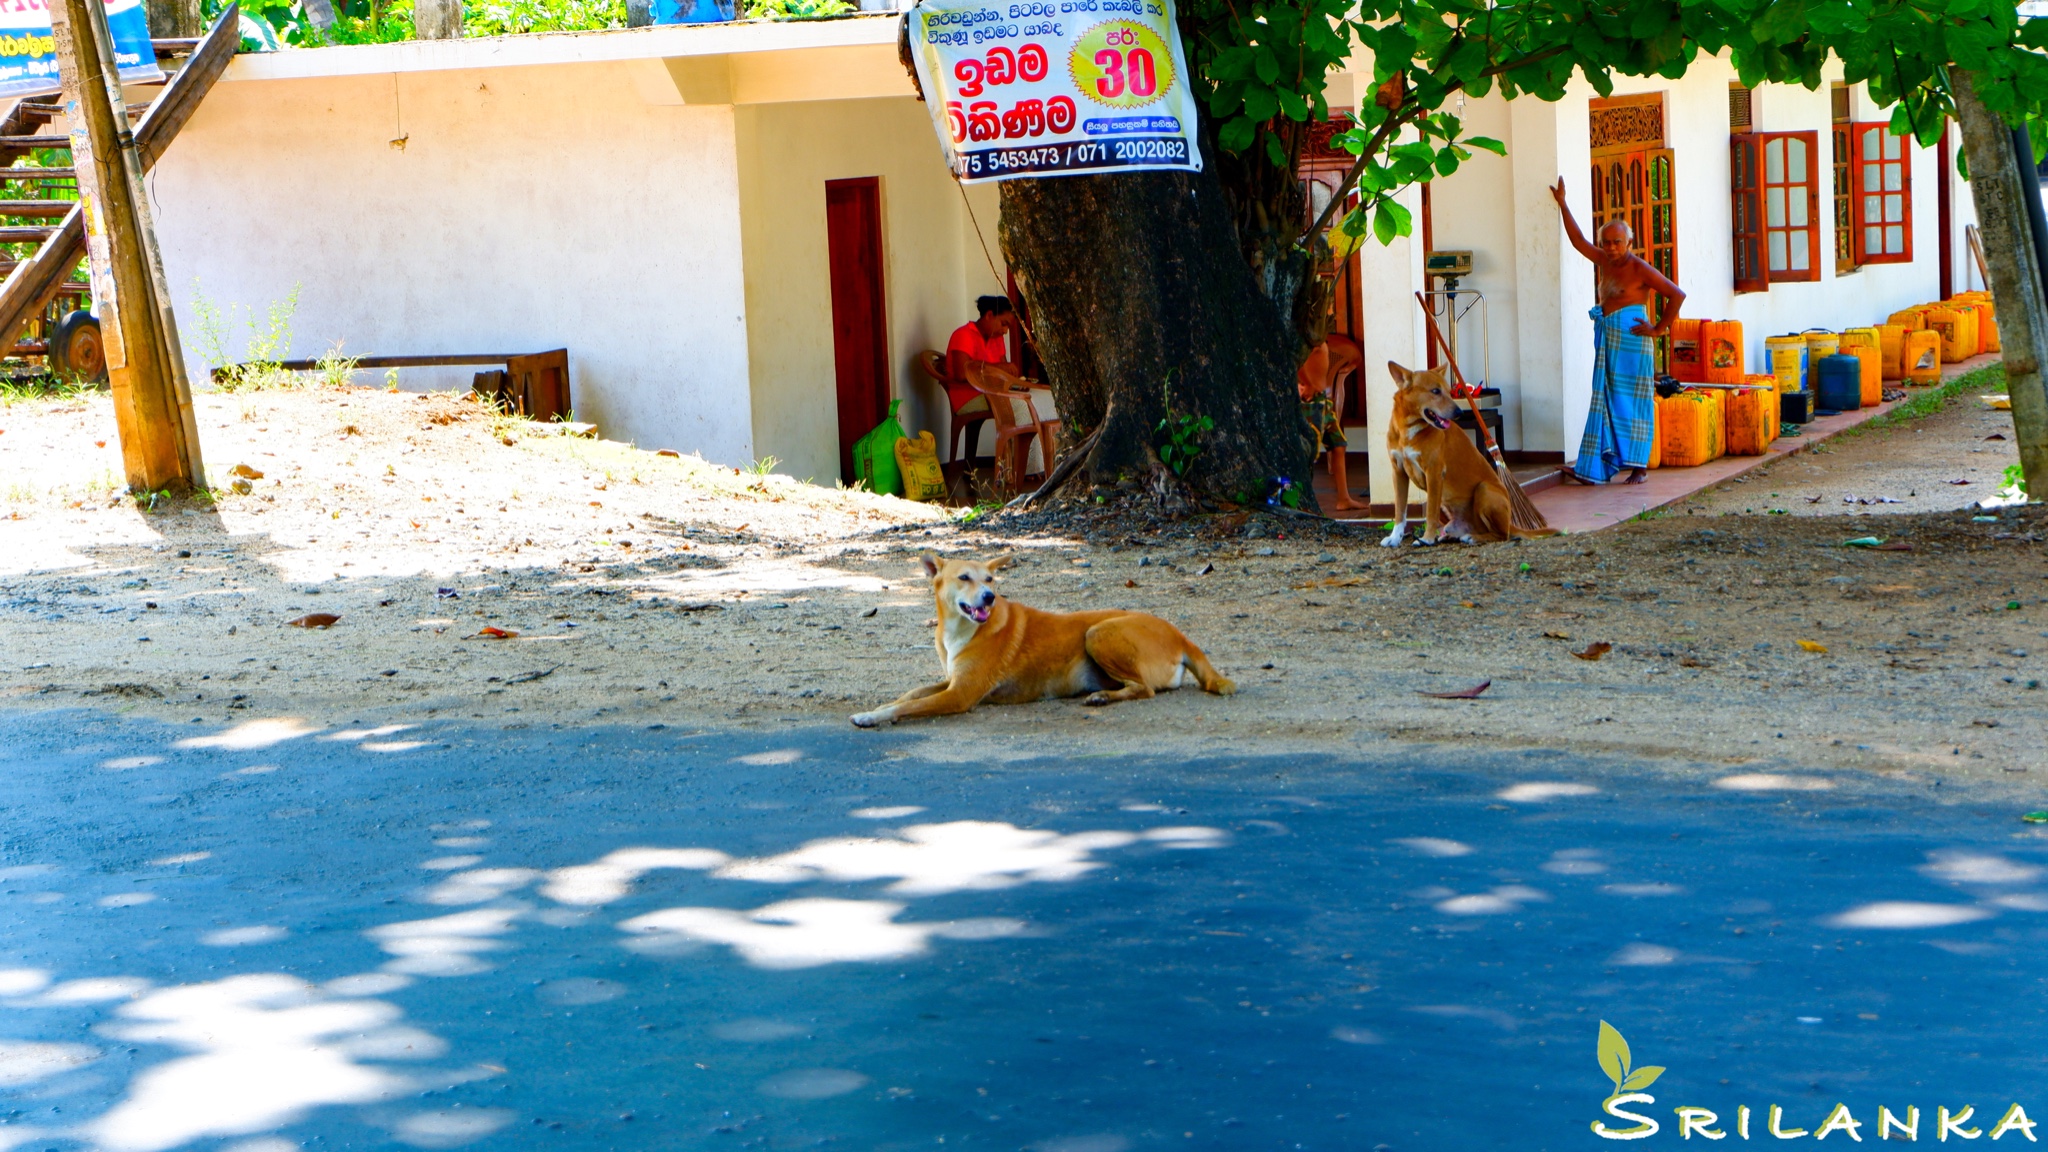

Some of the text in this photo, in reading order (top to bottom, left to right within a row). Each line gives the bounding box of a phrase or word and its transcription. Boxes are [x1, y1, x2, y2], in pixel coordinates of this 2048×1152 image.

[1024, 21, 1064, 36] යාබද
[954, 43, 1049, 98] ඉඩම
[1095, 48, 1157, 99] 30
[989, 147, 1060, 171] 5453473
[1065, 146, 1071, 166] /
[1077, 143, 1107, 162] 071
[1115, 141, 1186, 160] 2002082
